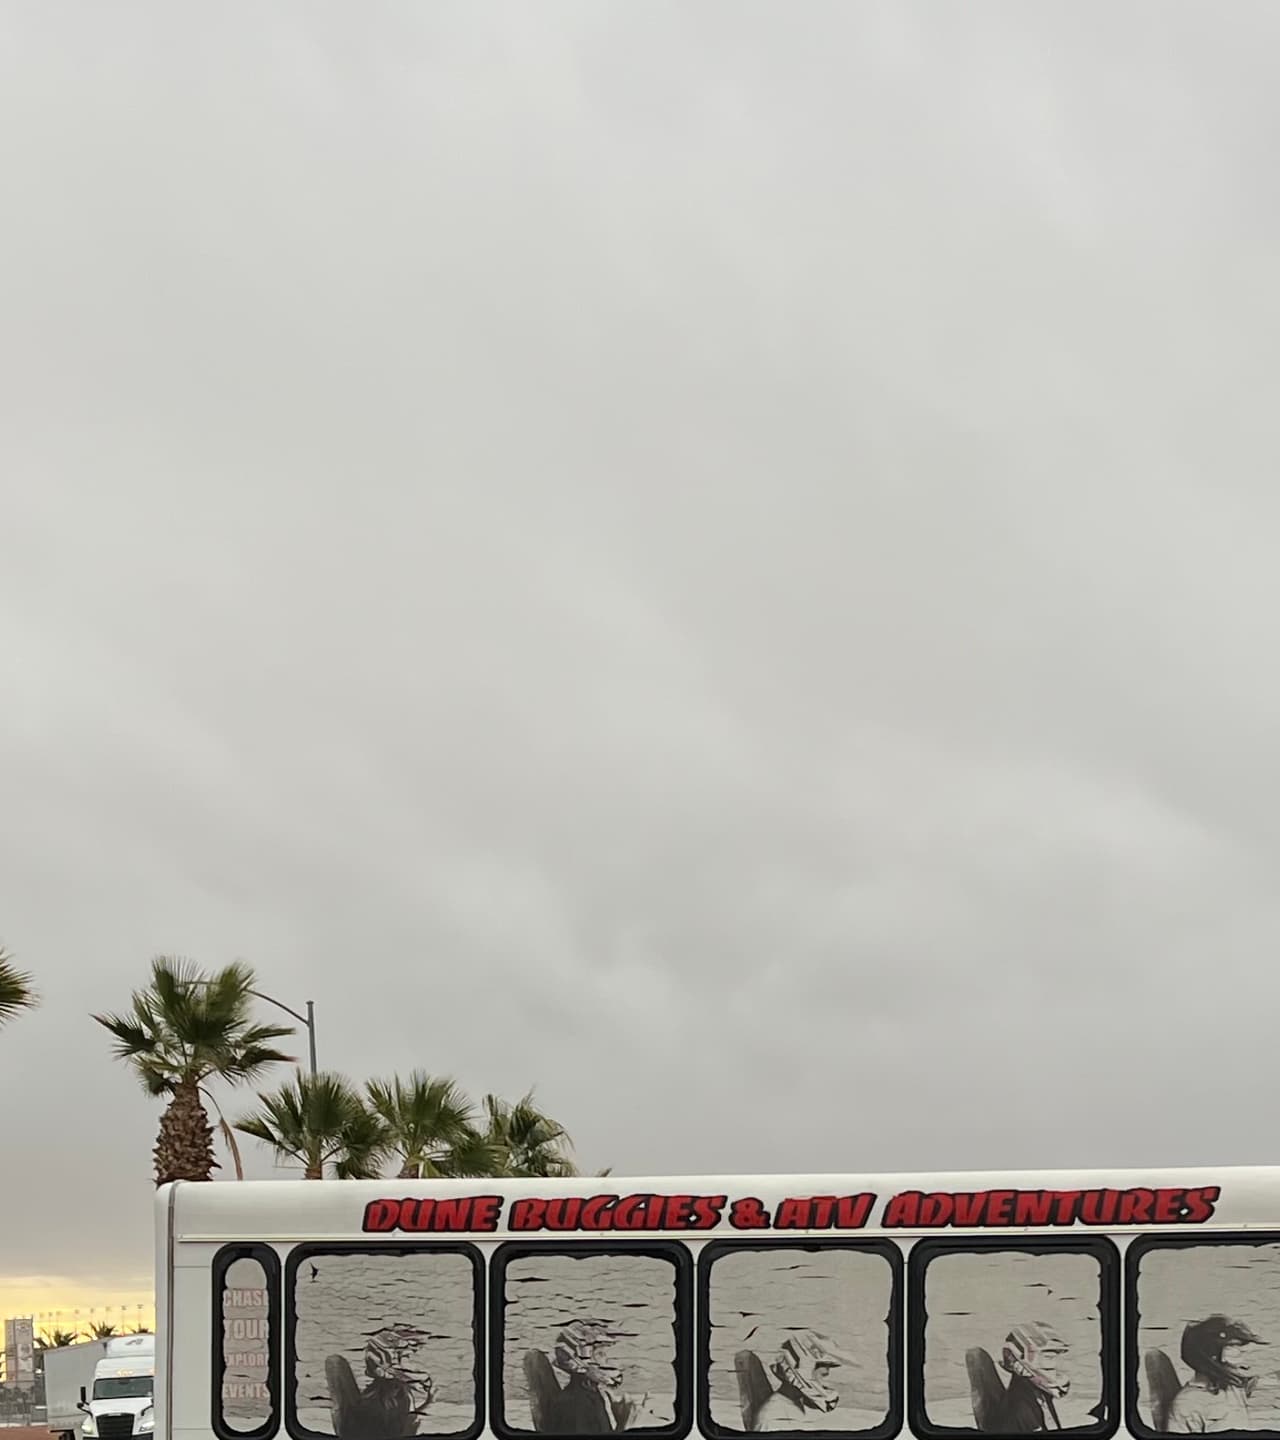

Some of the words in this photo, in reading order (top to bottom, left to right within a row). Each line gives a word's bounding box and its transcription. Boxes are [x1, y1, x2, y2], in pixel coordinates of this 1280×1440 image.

[362, 1196, 503, 1233] DUNE
[507, 1193, 727, 1232] BUGGIES
[728, 1194, 771, 1230] &
[773, 1192, 877, 1230] ATV
[880, 1186, 1222, 1229] ADVENTURES
[223, 1289, 268, 1307] CHAS
